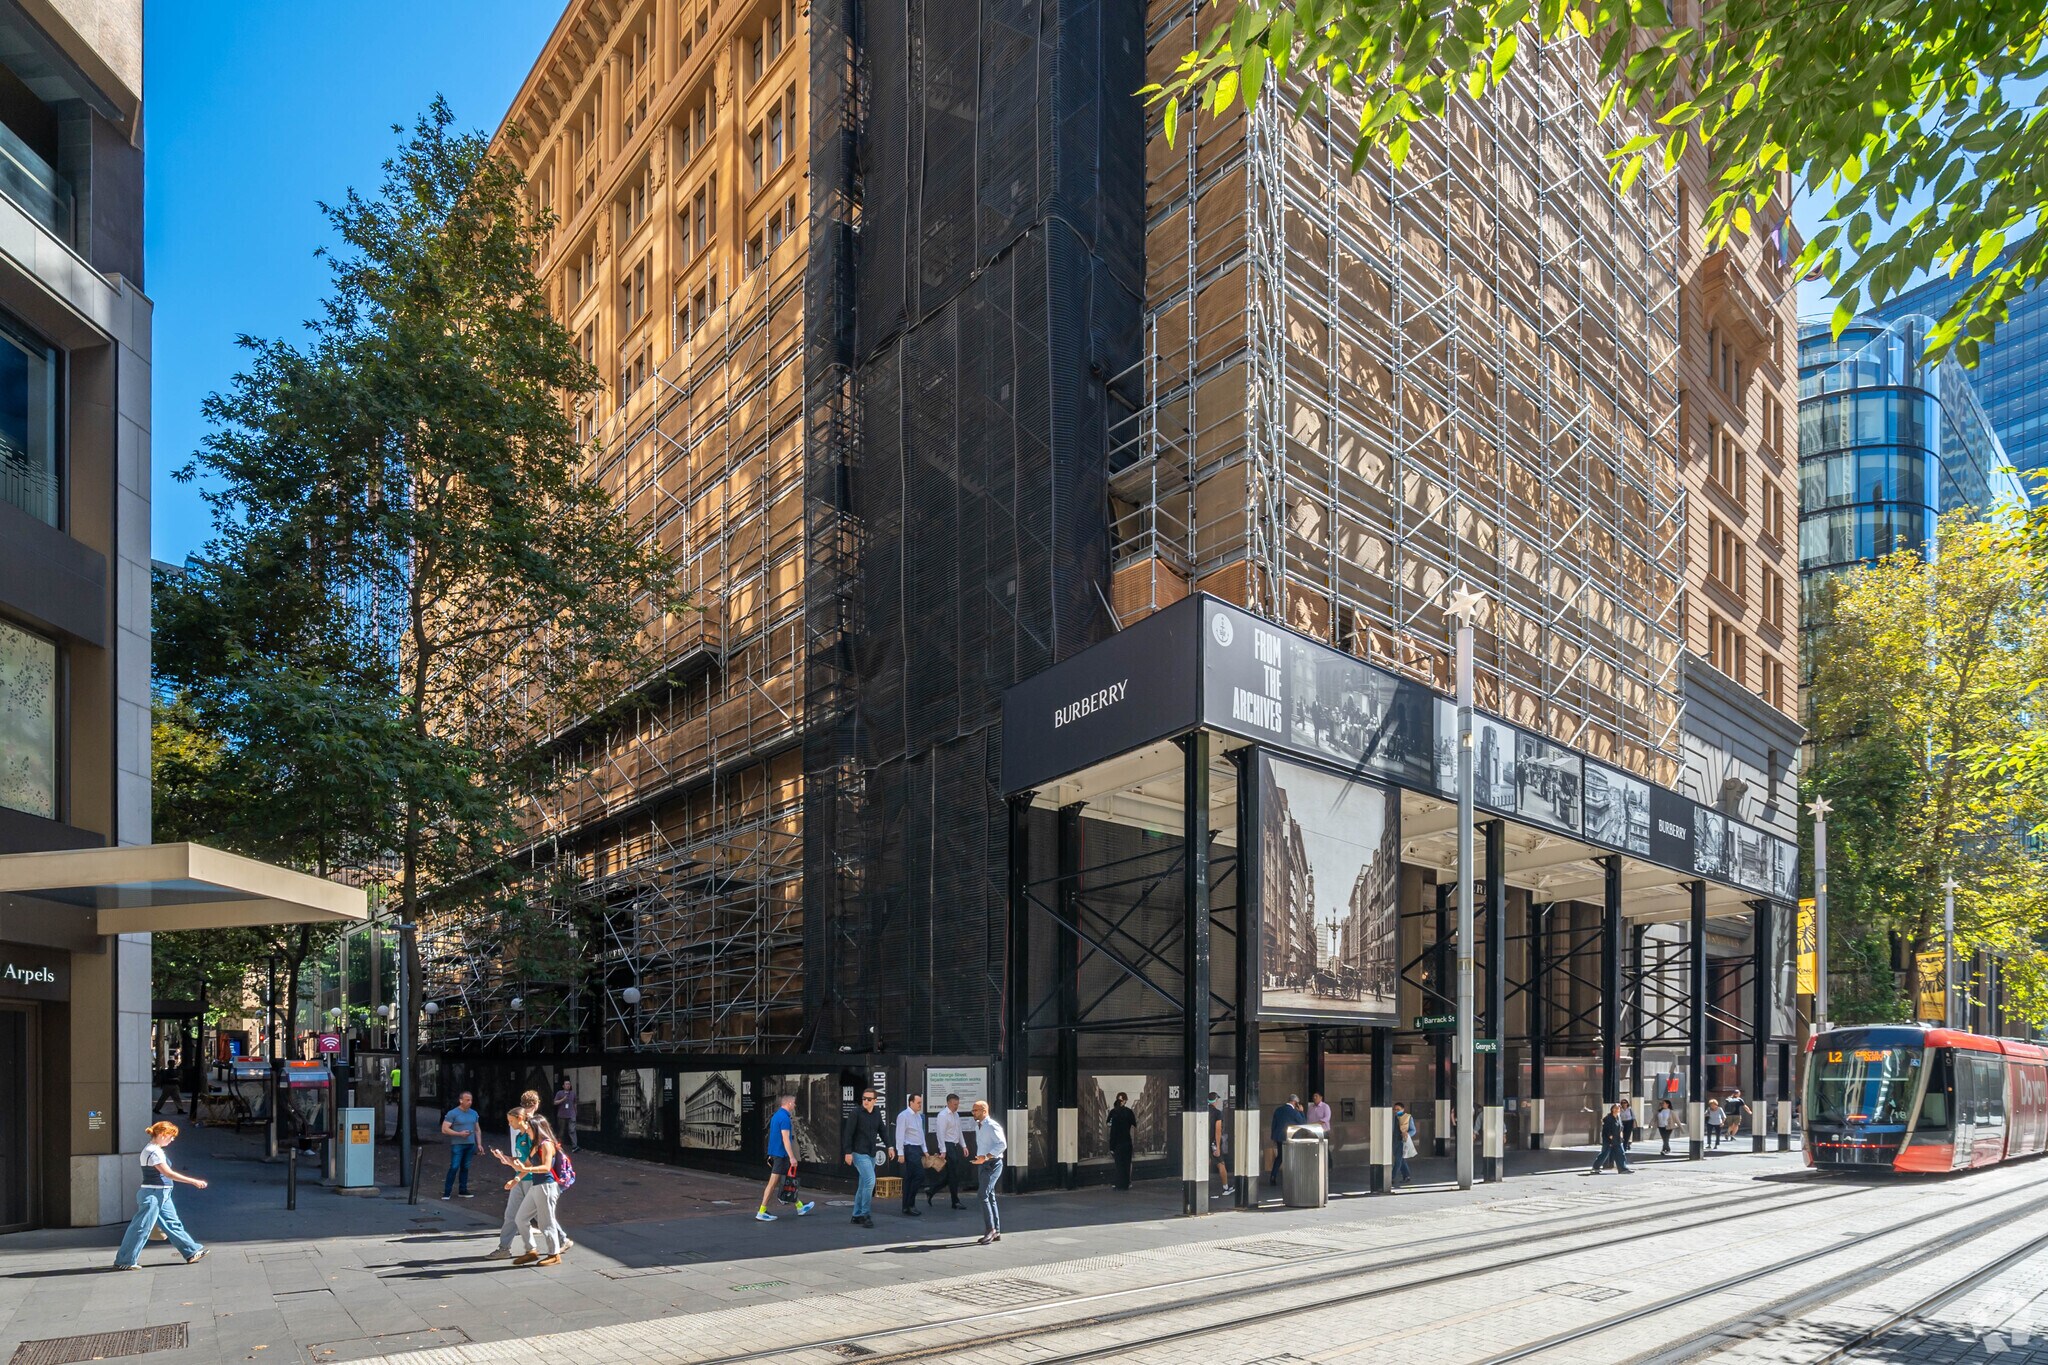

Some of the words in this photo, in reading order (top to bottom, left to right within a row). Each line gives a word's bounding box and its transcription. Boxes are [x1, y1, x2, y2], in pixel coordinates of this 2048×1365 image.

[1254, 627, 1281, 669] FROM
[1263, 664, 1281, 701] THE
[1054, 678, 1129, 729] BURBERRY
[1232, 686, 1282, 733] ARCHIVES
[1658, 818, 1687, 841] BURBERRY
[4, 963, 55, 985] Arpels
[1423, 1015, 1447, 1024] Barrack
[1475, 1042, 1489, 1052] George
[1489, 1042, 1497, 1050] St
[1828, 1051, 1843, 1063] L2
[873, 1071, 886, 1094] CITY
